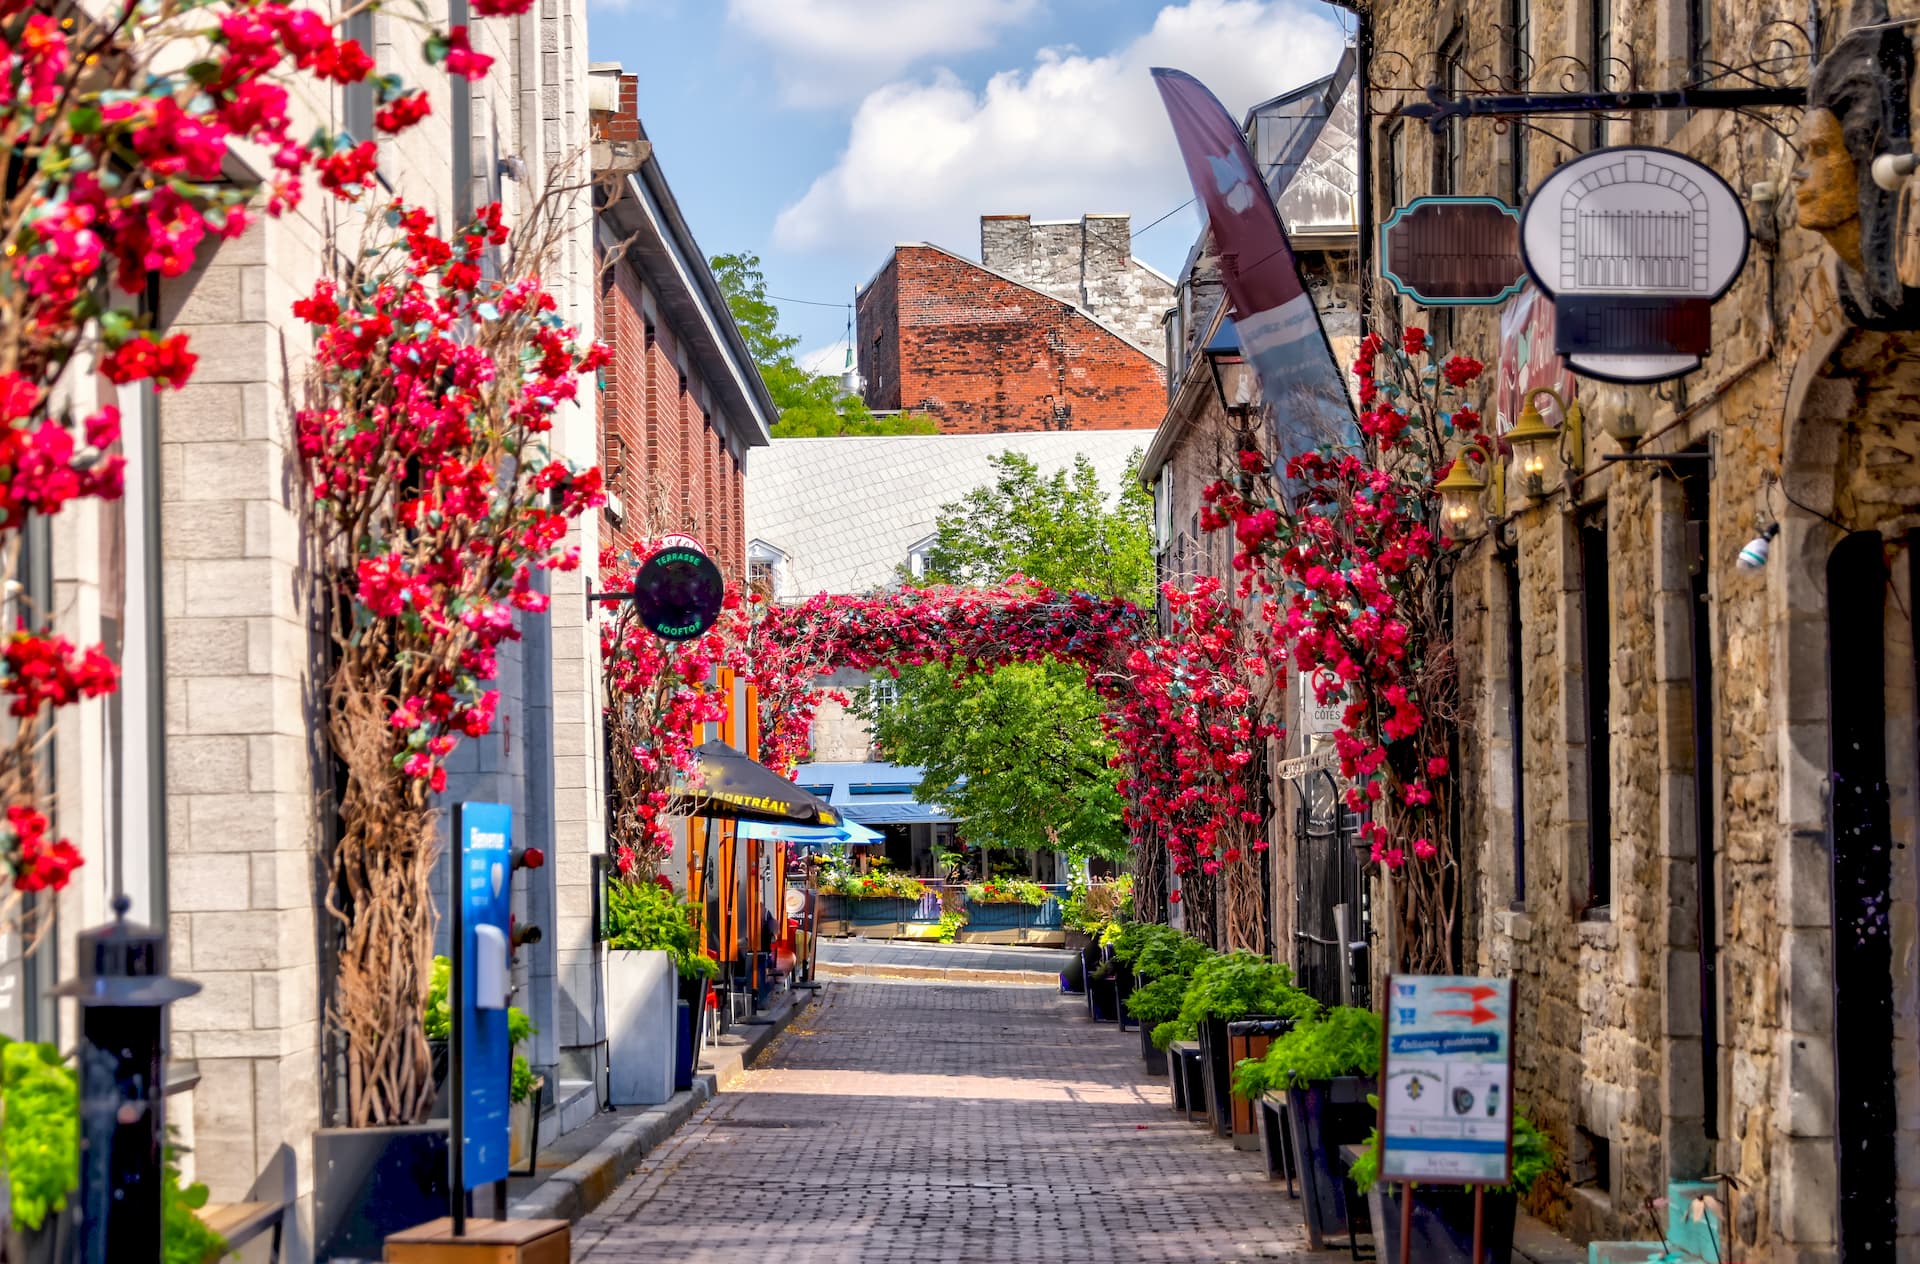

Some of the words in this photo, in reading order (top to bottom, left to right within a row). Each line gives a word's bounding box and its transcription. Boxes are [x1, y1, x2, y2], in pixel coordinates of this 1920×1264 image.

[655, 552, 702, 567] TERRASSE
[656, 620, 703, 636] ROOFTOP
[711, 791, 788, 814] MONTRÉAL
